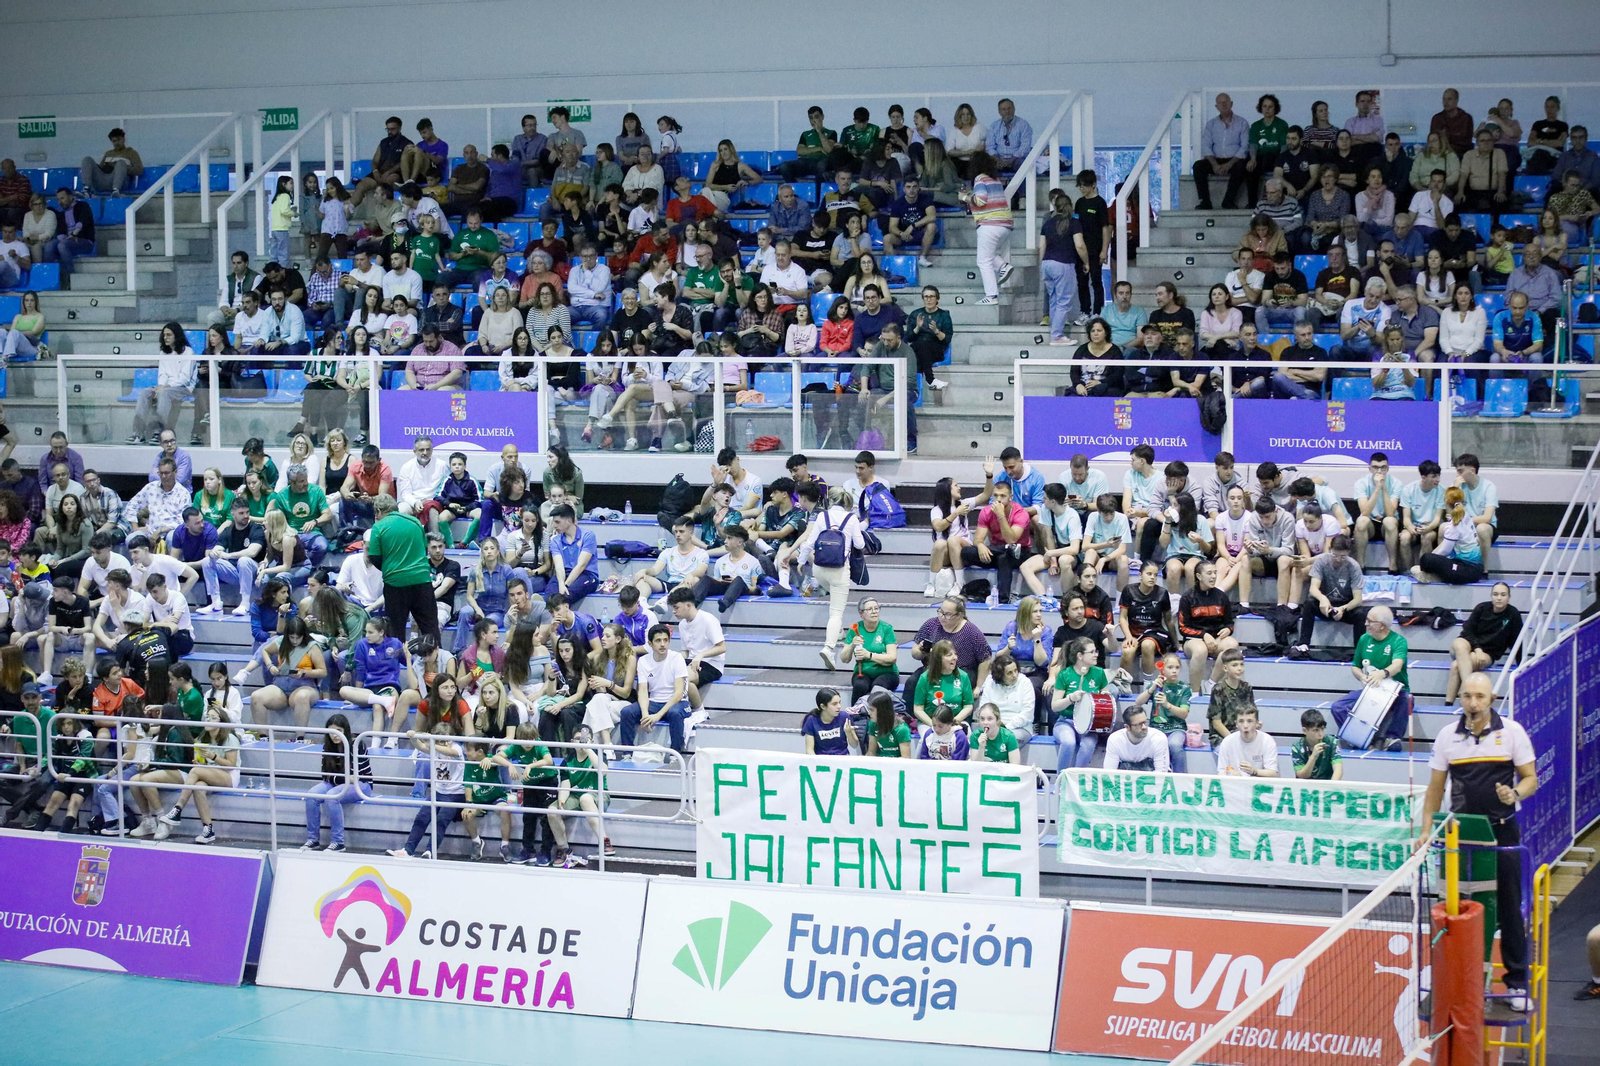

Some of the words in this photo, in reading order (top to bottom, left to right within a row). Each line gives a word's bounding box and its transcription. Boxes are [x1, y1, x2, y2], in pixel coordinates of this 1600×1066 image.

[20, 121, 55, 133] SALIDA
[262, 113, 296, 126] SALIDA
[404, 425, 459, 436] DIPUTACIÓN
[461, 427, 473, 437] DE
[475, 426, 515, 437] ALMERÍA
[1058, 435, 1123, 446] DIPUTACIÓN
[1126, 437, 1139, 446] DE
[1142, 436, 1188, 447] ALMERÍA
[1269, 437, 1336, 449] DIPUTACIÓN
[1338, 440, 1353, 449] DE
[1355, 439, 1403, 450] ALMERÍA
[1229, 831, 1274, 862] LA
[86, 920, 110, 938] DE
[112, 923, 192, 947] ALMERÍA
[419, 918, 527, 953] COSTA
[537, 927, 581, 957] DE
[787, 912, 1033, 968] Fundación
[375, 957, 575, 1010] ALMERÍA
[783, 957, 958, 1021] Unicaja
[1104, 1014, 1195, 1042] SUPERLIGA
[1200, 1023, 1279, 1049] VLEIBOL
[1281, 1030, 1383, 1059] MASCULINA
